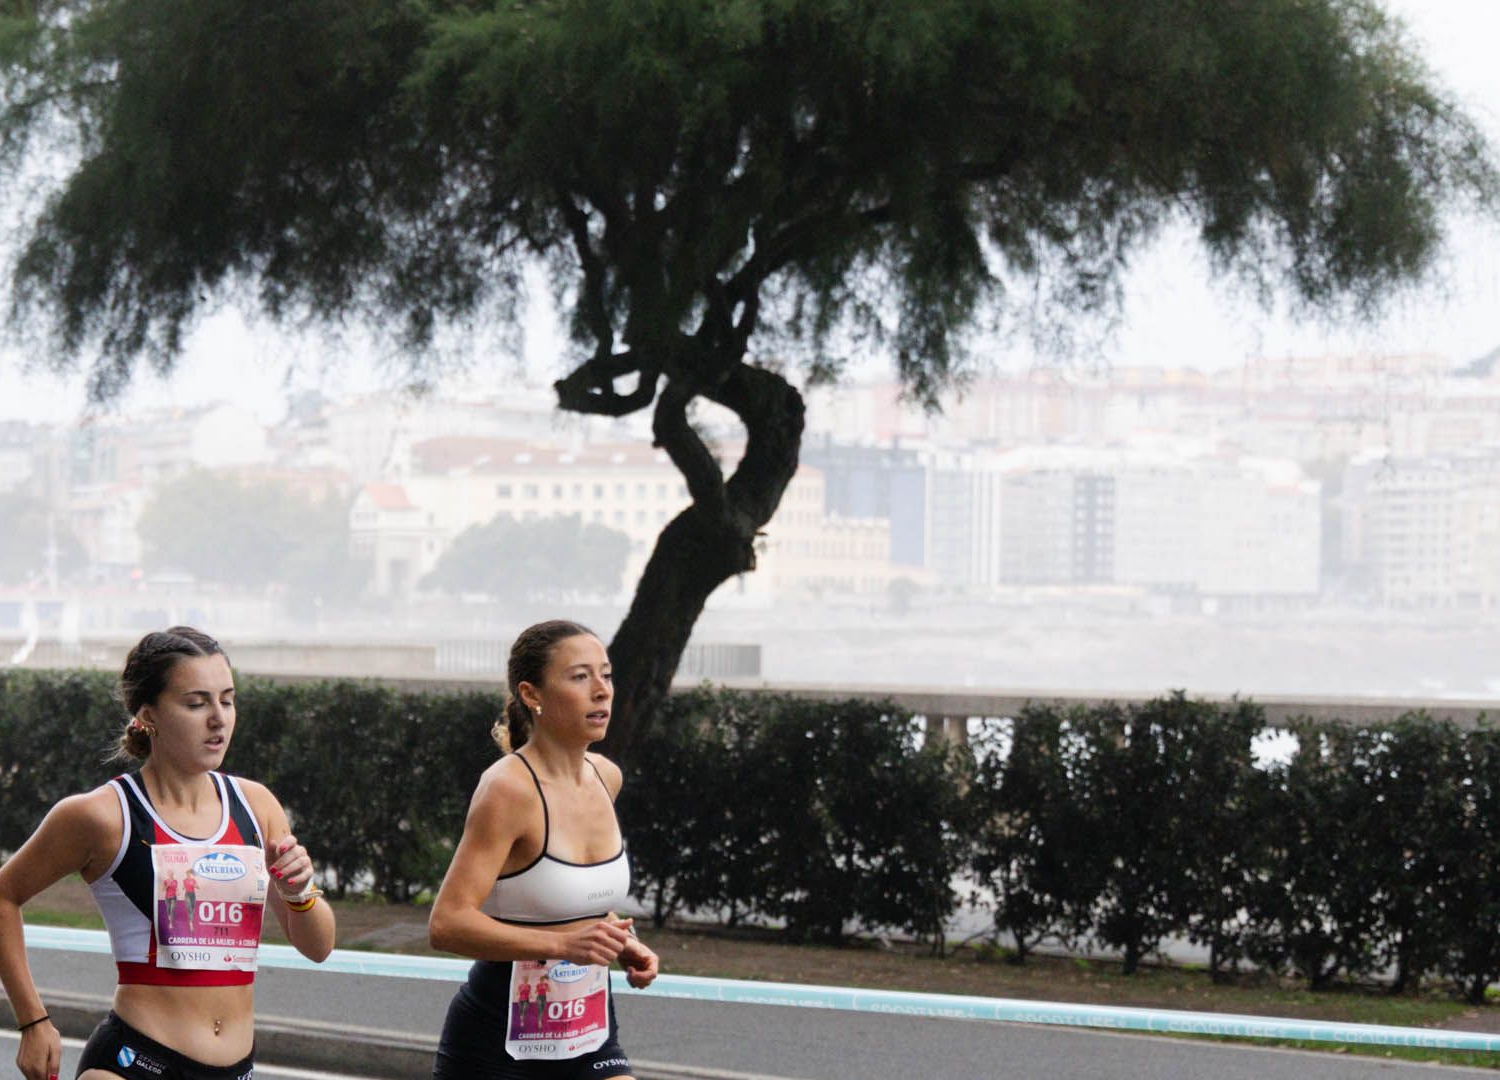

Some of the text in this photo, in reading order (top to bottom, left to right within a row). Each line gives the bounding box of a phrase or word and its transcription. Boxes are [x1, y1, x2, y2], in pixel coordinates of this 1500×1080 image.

[198, 862, 243, 874] ASTURIANA
[199, 901, 242, 923] 016
[213, 926, 228, 936] 711
[207, 937, 215, 945] LA
[171, 951, 211, 961] OYSHO
[548, 998, 585, 1019] 016
[519, 1044, 556, 1053] OYSHO
[136, 1059, 162, 1076] GALEGO
